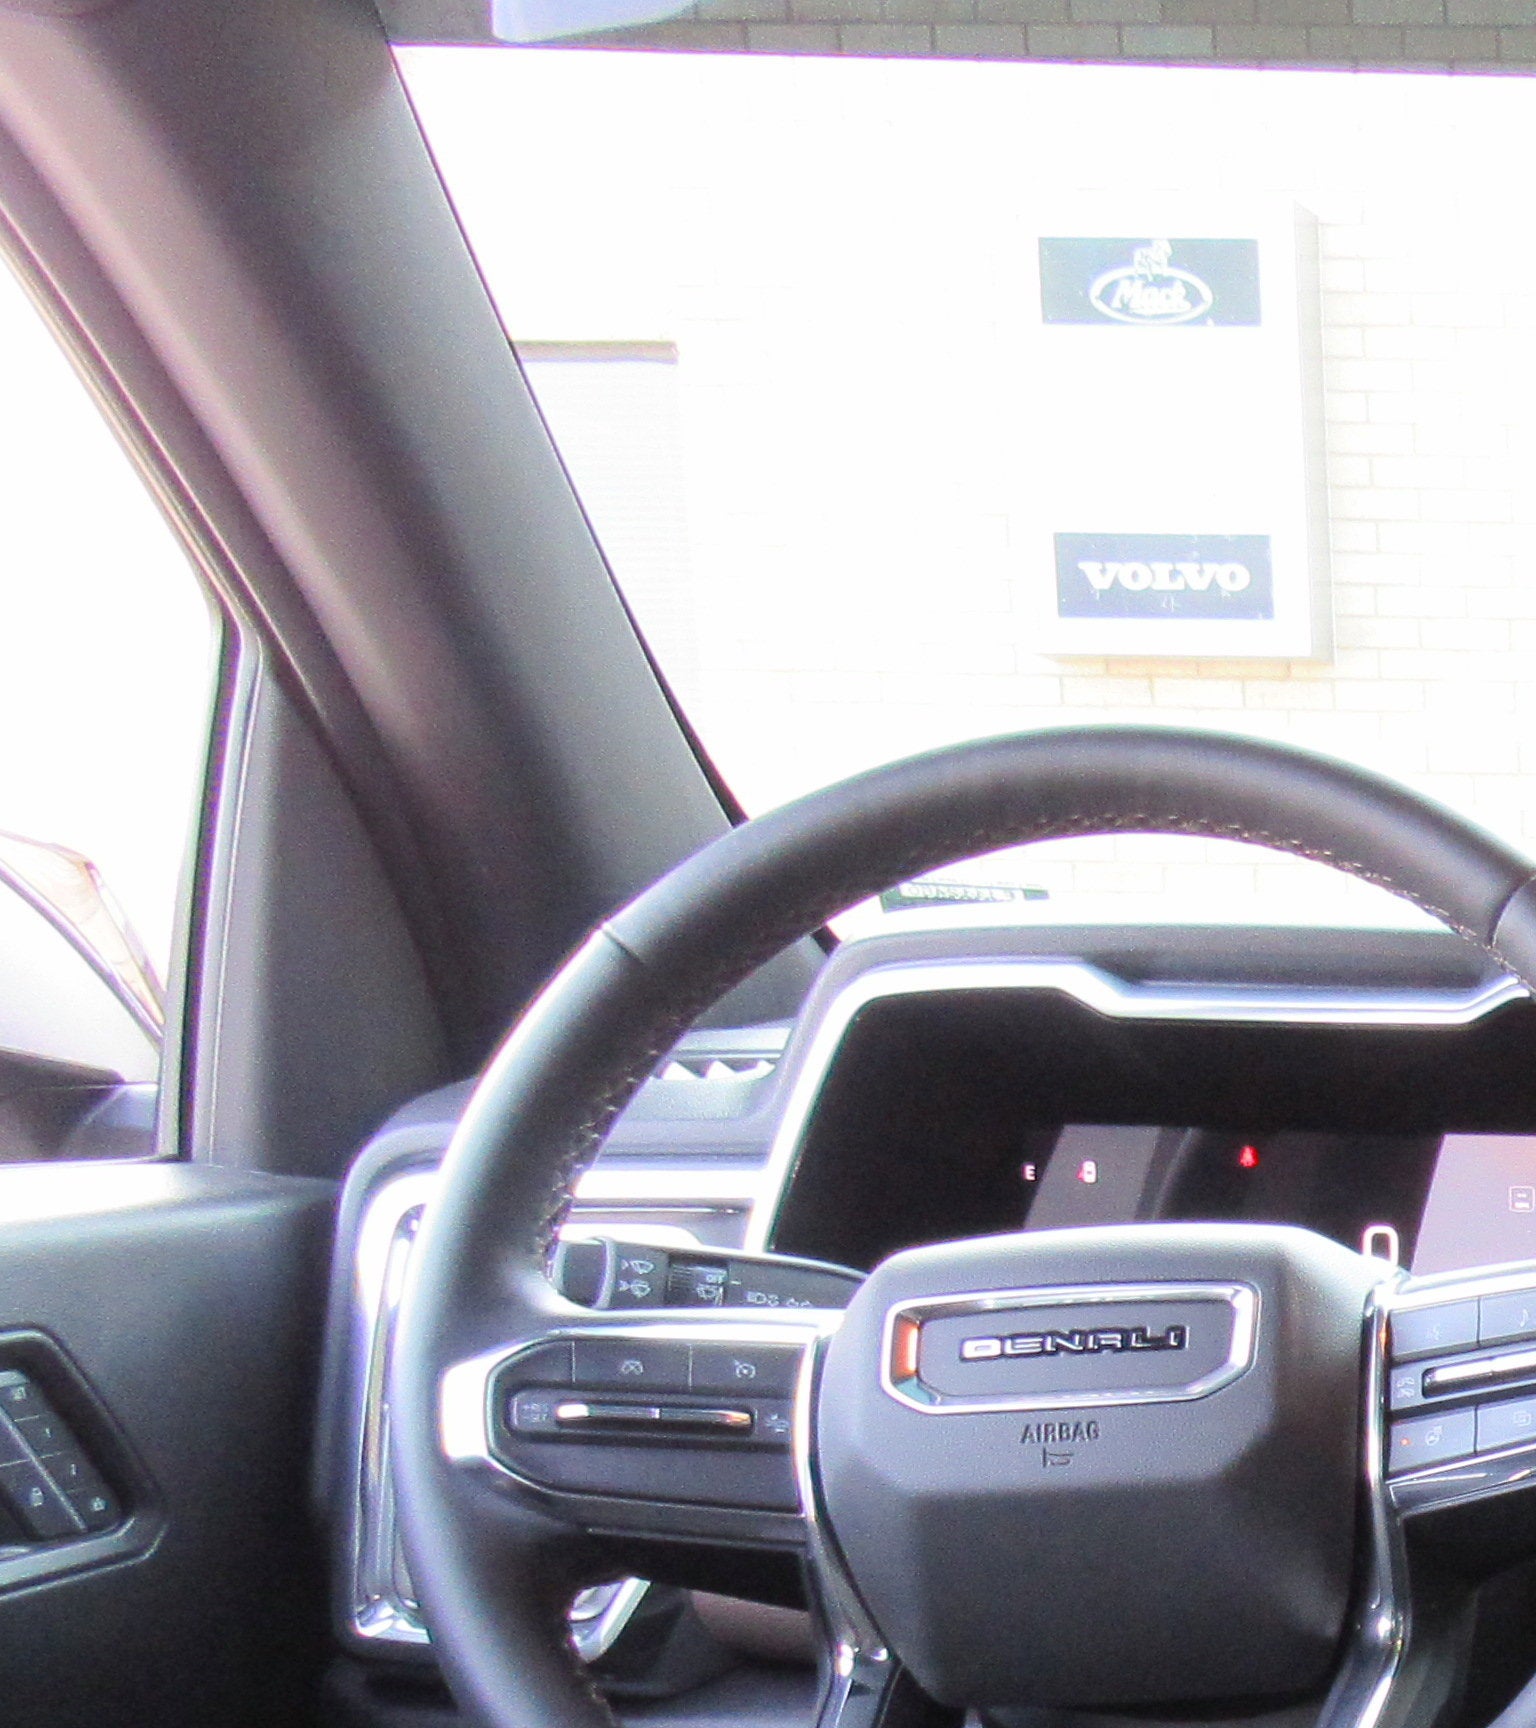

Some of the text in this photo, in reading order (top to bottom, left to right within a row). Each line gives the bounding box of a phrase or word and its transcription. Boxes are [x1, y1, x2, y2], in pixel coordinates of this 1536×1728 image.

[1111, 279, 1192, 313] Mack
[1078, 561, 1251, 593] VOLVO
[1023, 1162, 1036, 1182] E
[959, 1326, 1189, 1361] DENALI
[1020, 1421, 1101, 1444] AIRBAG
